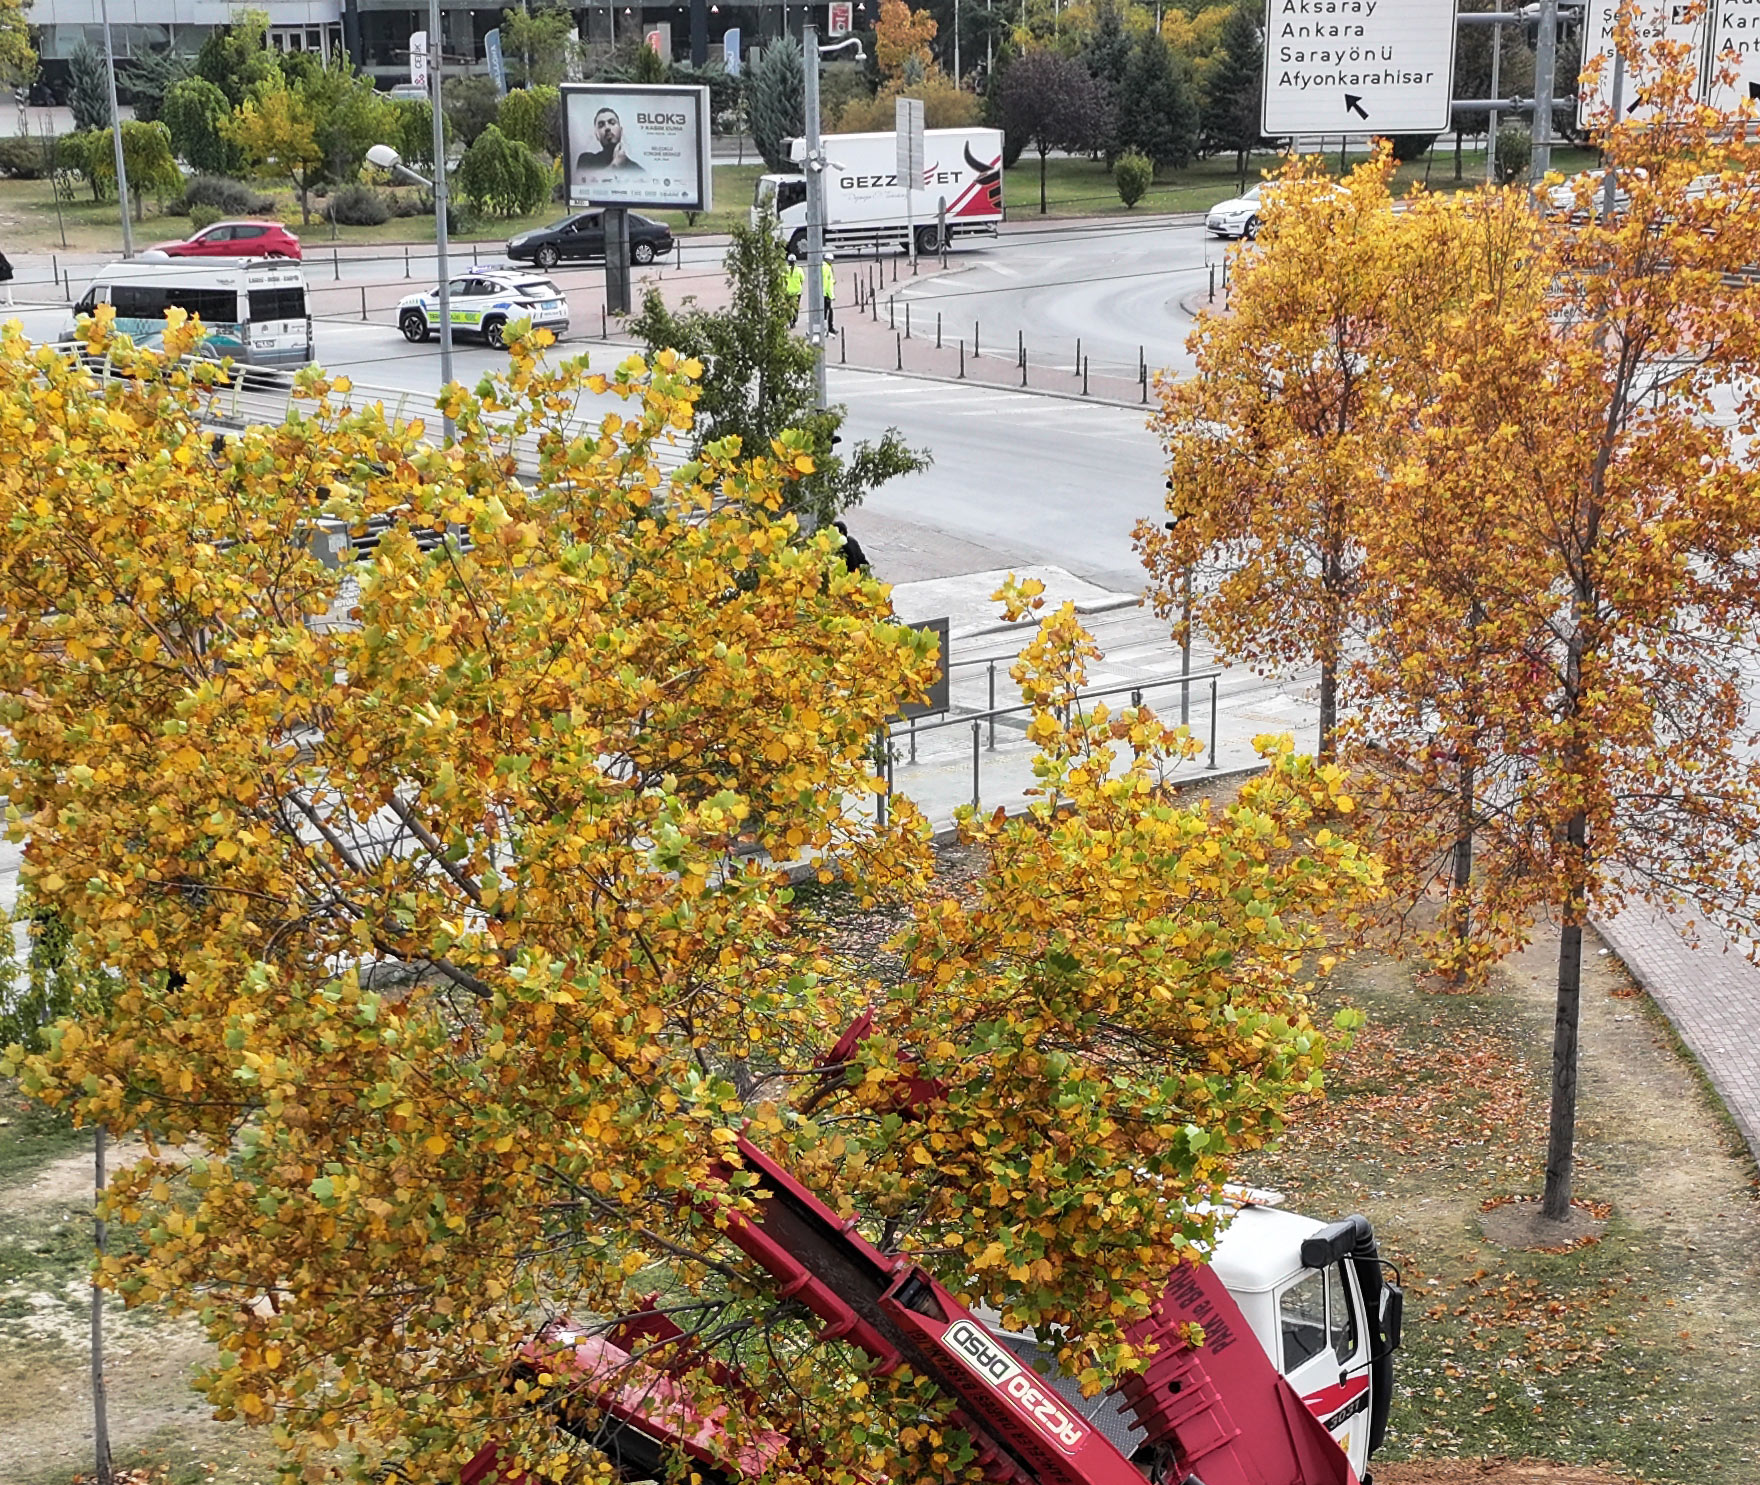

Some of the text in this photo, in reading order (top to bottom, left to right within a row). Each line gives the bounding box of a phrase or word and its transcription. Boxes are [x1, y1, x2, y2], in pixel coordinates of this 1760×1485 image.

[1282, 0, 1377, 17] Aksaray
[1602, 8, 1647, 24] Şeir
[1281, 22, 1364, 38] Ankara
[1601, 24, 1663, 39] Mkez
[1280, 46, 1393, 66] Sarayönü
[1279, 70, 1434, 90] Afyonkarahisar
[637, 113, 686, 125] BLOK3
[1168, 1264, 1236, 1355] PARK ve BAHÇ
[952, 1326, 1083, 1446] AC230 DASD
